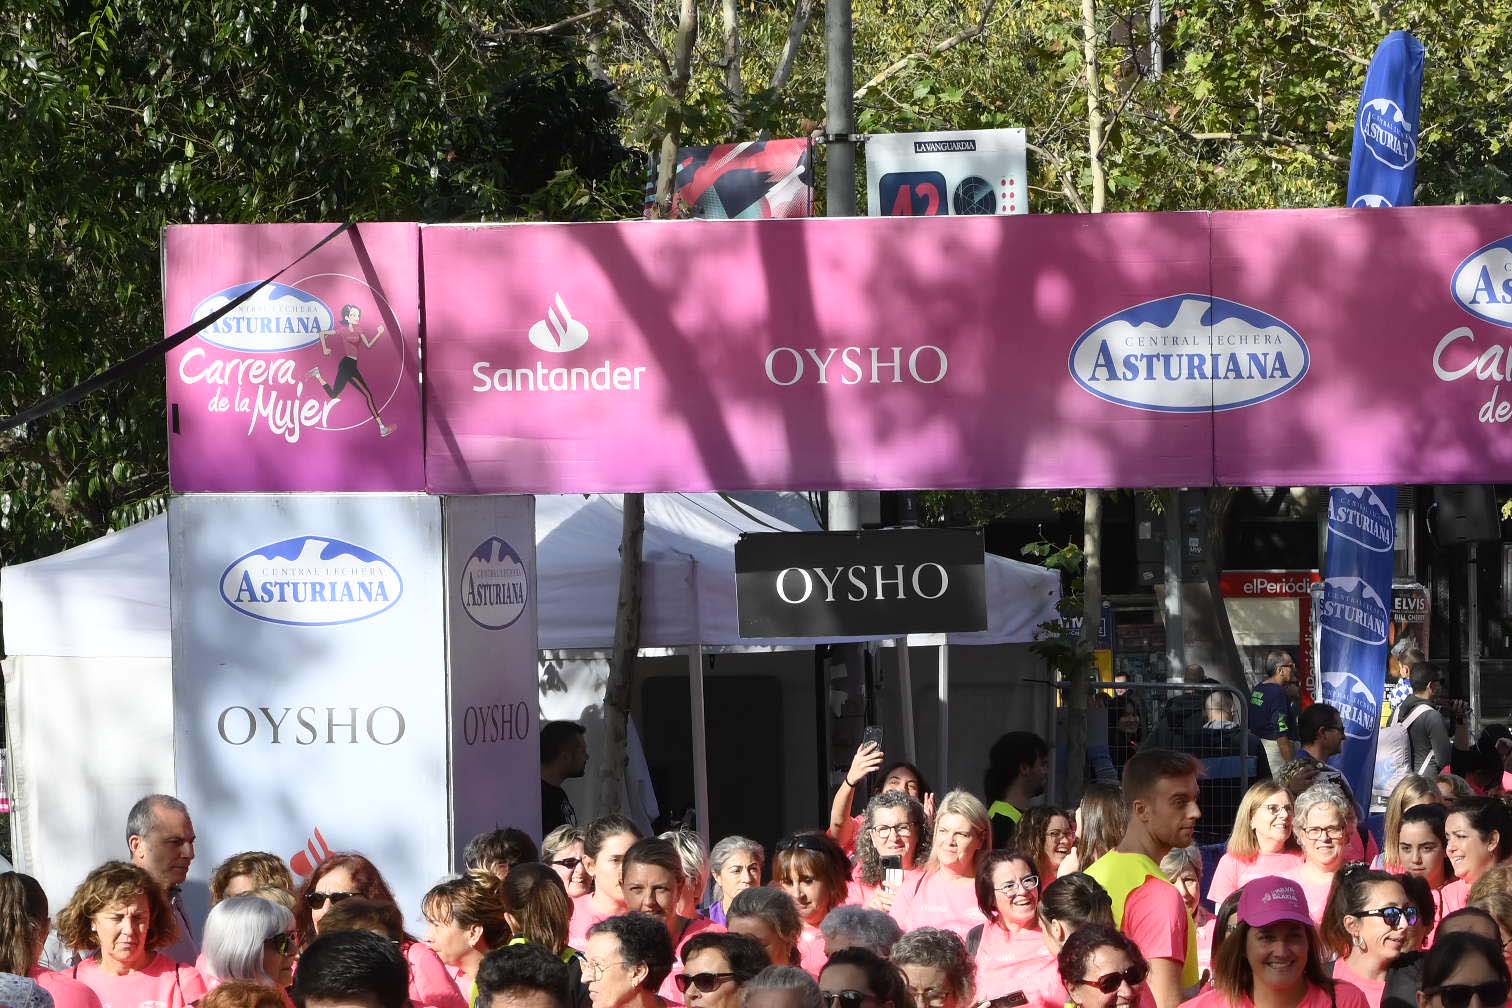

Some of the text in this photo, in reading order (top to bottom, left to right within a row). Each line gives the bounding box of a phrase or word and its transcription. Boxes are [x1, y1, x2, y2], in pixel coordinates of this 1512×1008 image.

[1125, 334, 1283, 349] CENTRAL LECHERA
[179, 348, 296, 385] Carrera
[472, 360, 646, 393] Santander
[764, 344, 949, 386] OYSHO
[1089, 338, 1292, 383] ASTURIANA
[208, 381, 342, 444] de la Mujer
[1478, 391, 1512, 424] de
[233, 570, 390, 604] ASTURIANA
[262, 566, 386, 577] CENTRAL LECHERA
[467, 572, 525, 607] ASTURIANA
[774, 562, 949, 605] OYSHO
[1322, 599, 1386, 638] STURIANA
[1395, 598, 1426, 611] ELVIS
[217, 705, 406, 747] OYSHO
[463, 701, 530, 746] OYSHO
